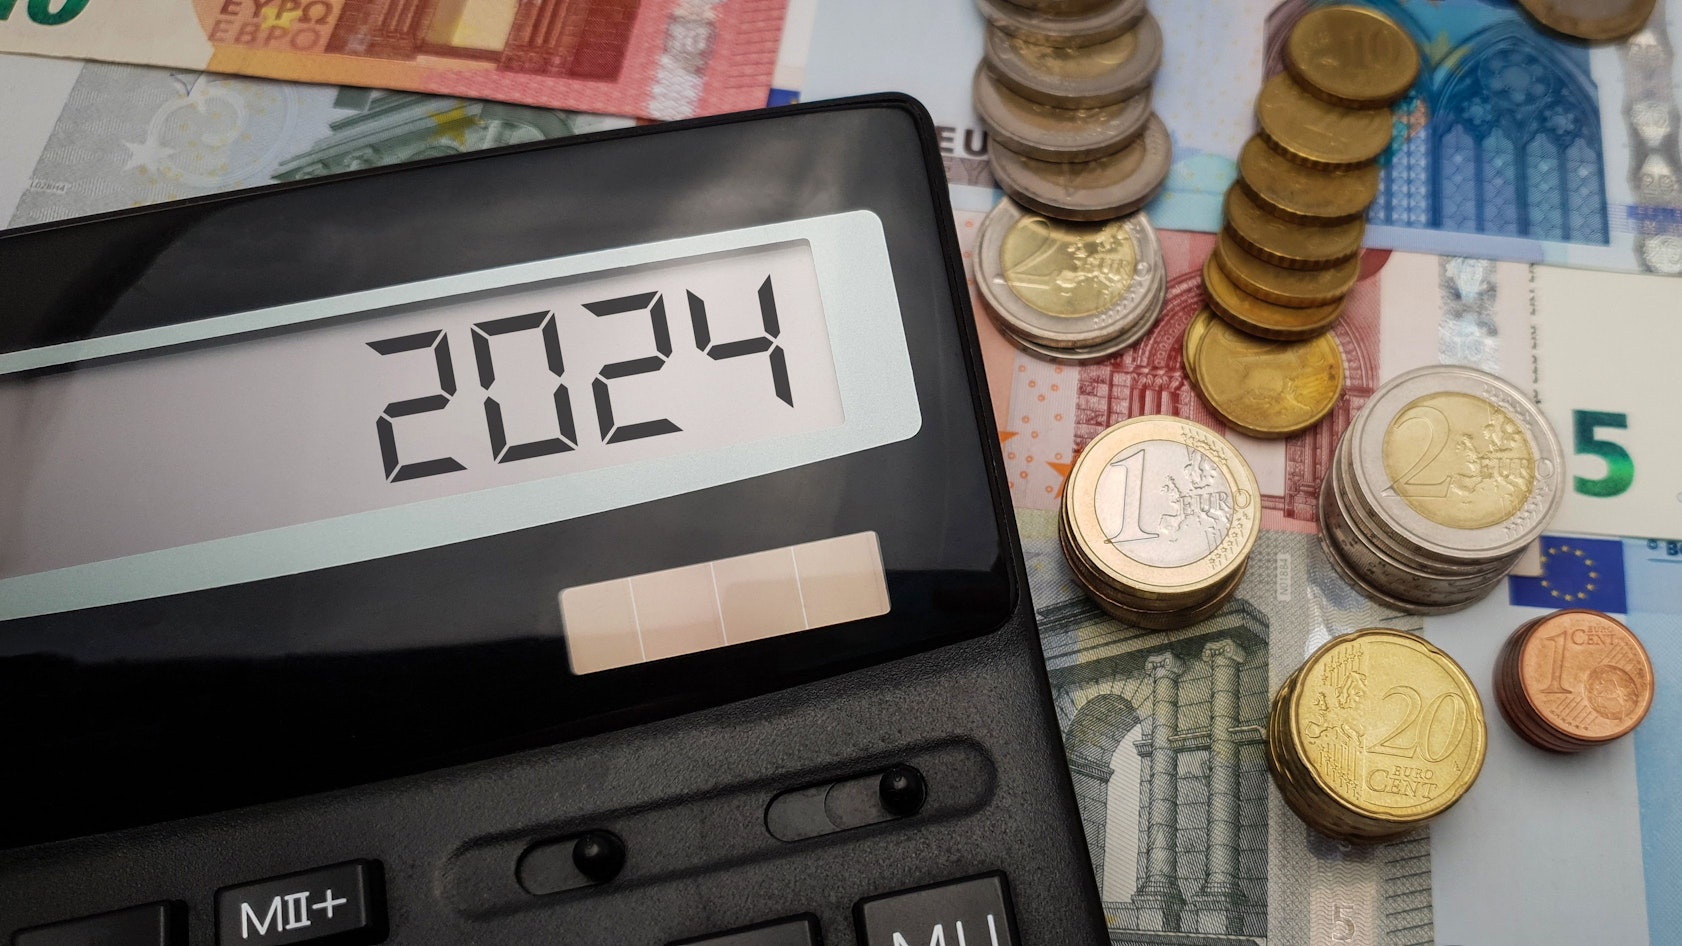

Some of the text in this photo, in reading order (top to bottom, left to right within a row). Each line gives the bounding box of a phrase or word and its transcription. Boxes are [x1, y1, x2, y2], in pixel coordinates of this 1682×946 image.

[364, 273, 795, 484] 2024
[1379, 405, 1452, 499] 2
[1572, 409, 1636, 499] 5
[1103, 448, 1161, 545] 1
[1539, 629, 1573, 695] 1
[1365, 685, 1468, 764] 20
[1392, 765, 1434, 781] EURO
[1331, 902, 1356, 942] 5
